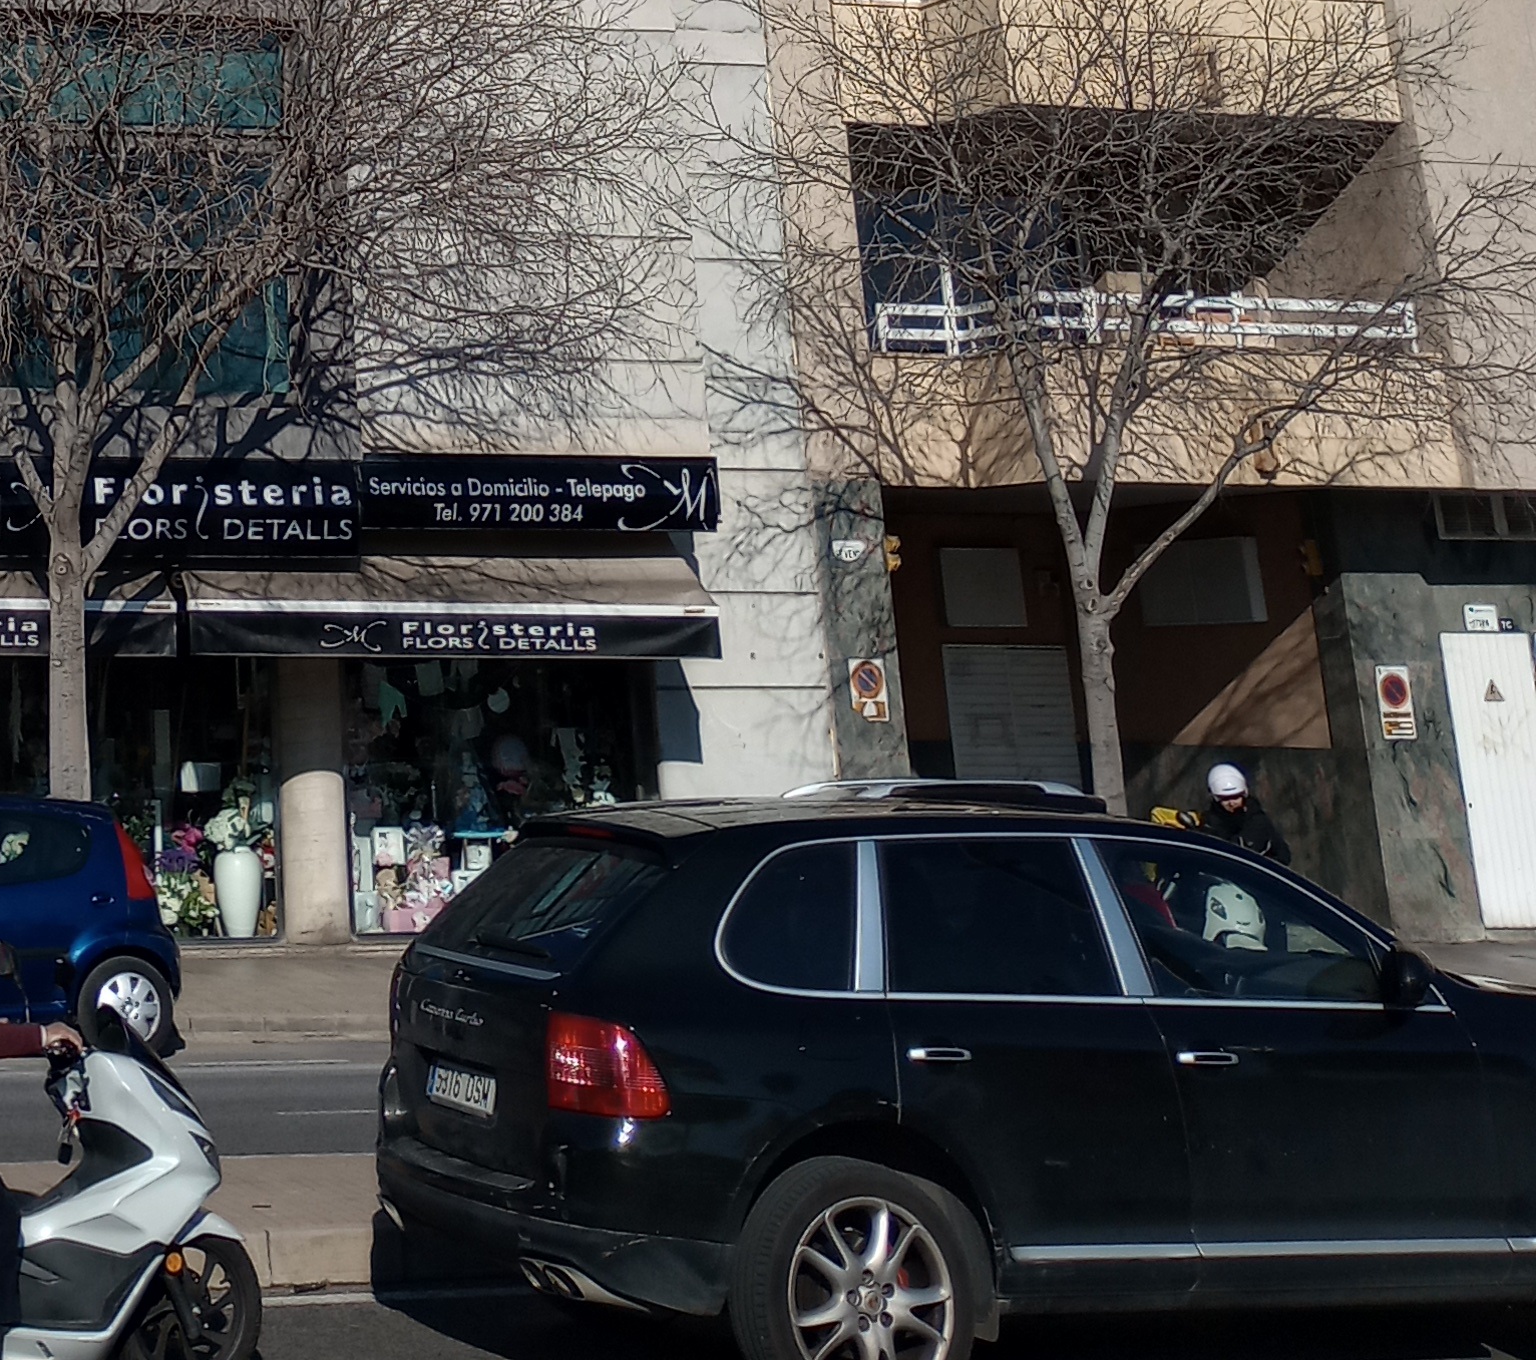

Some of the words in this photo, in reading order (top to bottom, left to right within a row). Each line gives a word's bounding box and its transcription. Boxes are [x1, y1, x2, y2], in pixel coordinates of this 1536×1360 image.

[94, 476, 353, 506] Foristeria
[369, 477, 446, 496] Servicios
[450, 483, 462, 496] a
[467, 478, 550, 497] Domicilio
[567, 479, 646, 502] Telepago
[434, 503, 462, 521] Tel.
[469, 504, 501, 522] 971
[508, 504, 544, 522] 200
[549, 504, 584, 522] 384
[223, 519, 353, 541] DETALLS
[402, 620, 596, 637] Floristeria
[402, 637, 474, 649] FLORS
[499, 638, 597, 650] DETALLS
